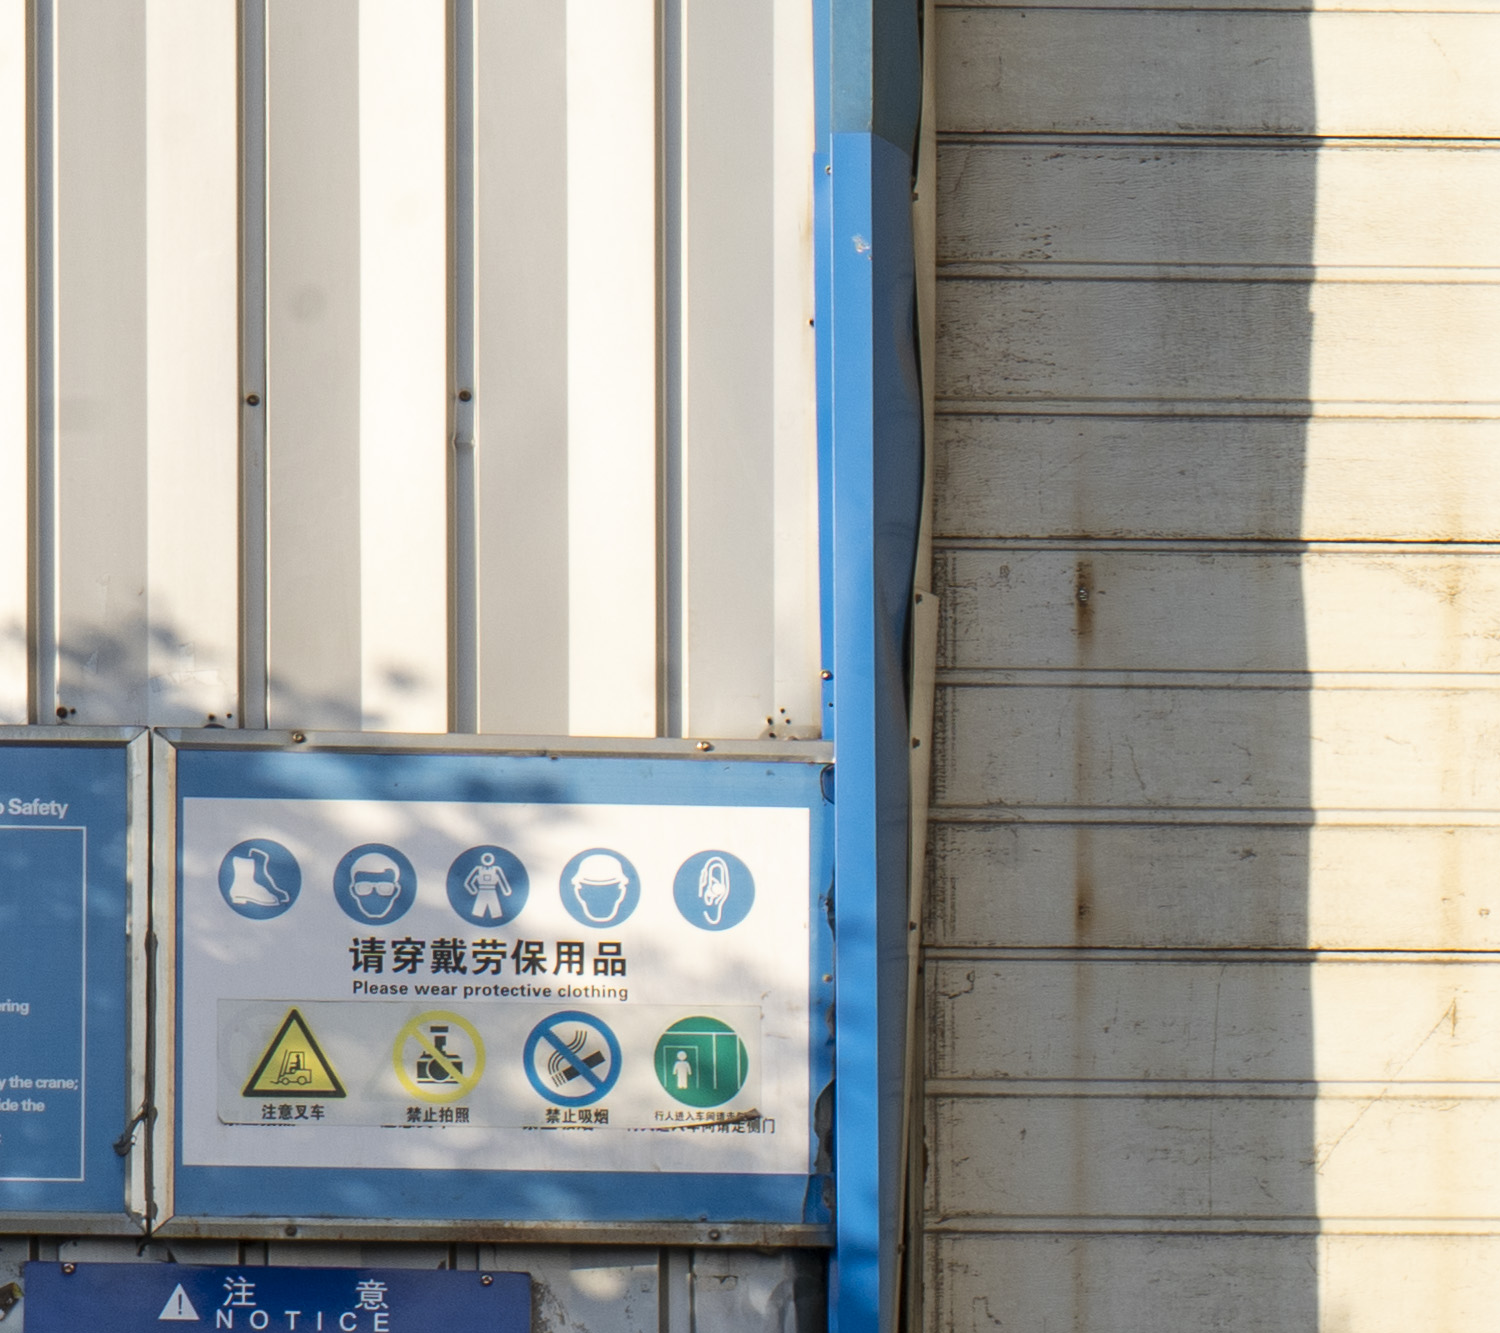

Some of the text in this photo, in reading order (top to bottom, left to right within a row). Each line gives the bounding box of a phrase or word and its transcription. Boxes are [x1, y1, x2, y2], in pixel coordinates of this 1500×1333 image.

[8, 797, 69, 820] Safety
[349, 937, 627, 977] 请穿戴劳保用品
[352, 980, 629, 1002] Please wear protective clothing
[9, 1075, 33, 1089] the
[35, 1078, 79, 1091] crane;
[21, 1098, 46, 1112] the
[261, 1103, 325, 1121] 注意叉车
[406, 1106, 470, 1123] 禁止拍照
[545, 1108, 609, 1125] 禁止吸烟
[223, 1275, 389, 1311] 注意
[216, 1308, 391, 1333] NOTICE
